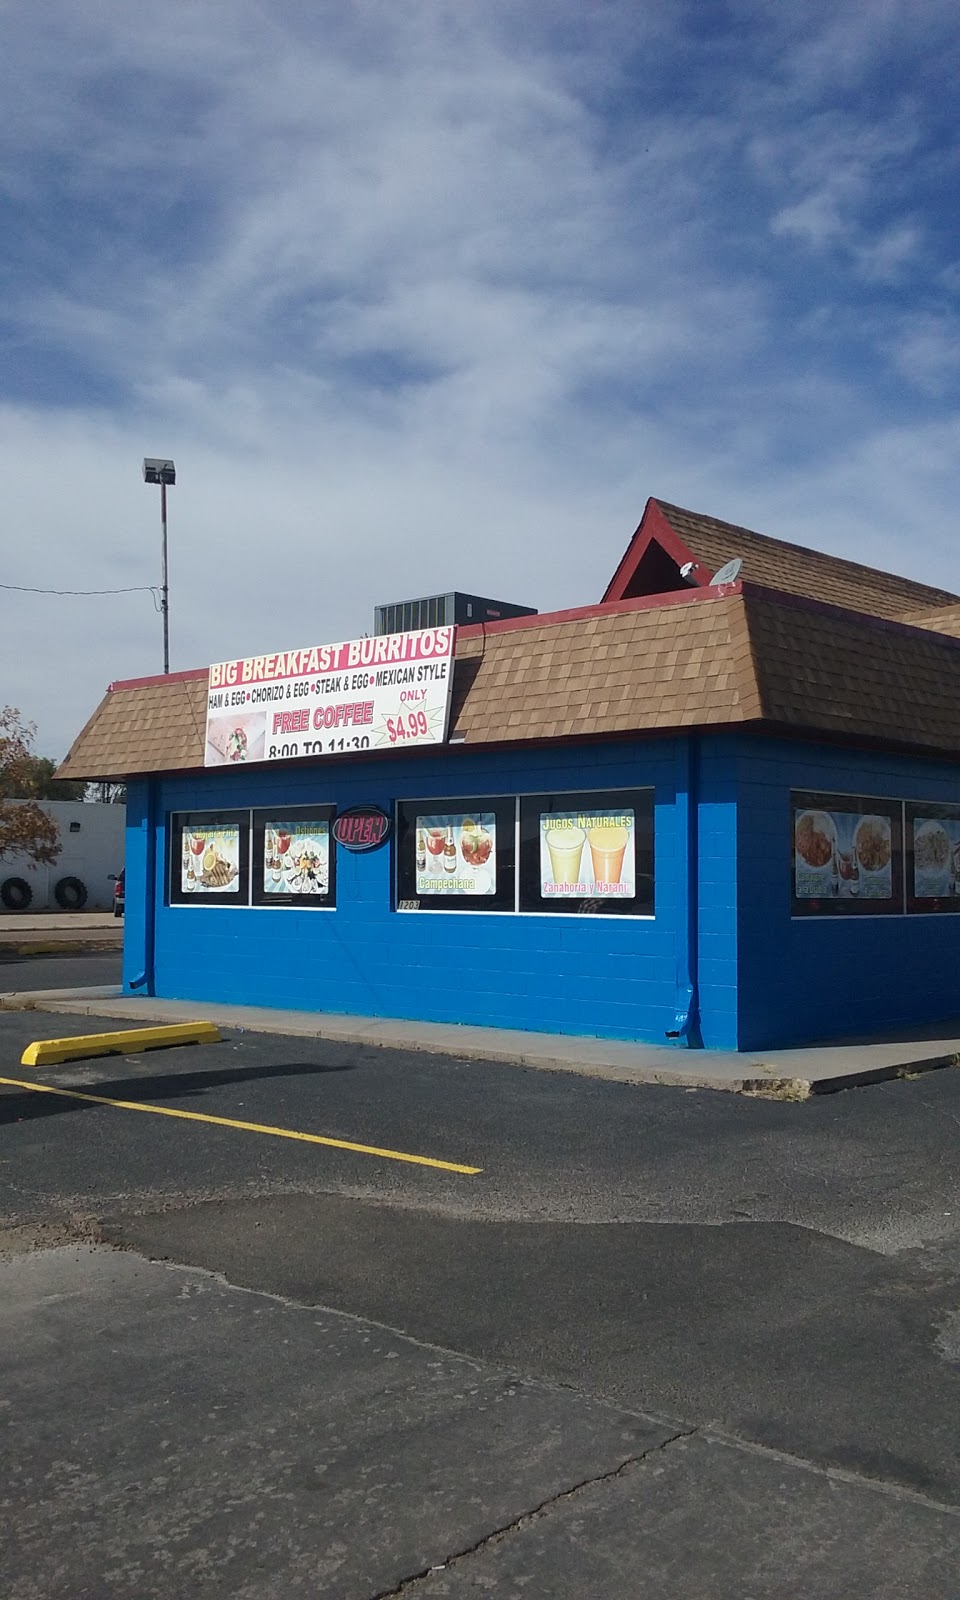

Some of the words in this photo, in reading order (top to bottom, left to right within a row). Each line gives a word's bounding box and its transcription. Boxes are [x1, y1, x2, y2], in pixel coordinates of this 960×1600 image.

[211, 661, 238, 687] BIG
[241, 645, 344, 683] BREAKFAST
[346, 628, 449, 667] BURRITOS
[208, 695, 223, 710] HAM
[224, 693, 230, 707] &
[231, 690, 246, 706] EGG
[251, 684, 284, 704] CHORIZO
[286, 684, 291, 699] &
[293, 681, 309, 698] EGG
[315, 676, 341, 695] STEAK
[343, 676, 349, 691] &
[351, 673, 369, 690] EGG
[375, 665, 415, 687] MEXICAN
[417, 662, 447, 682] STYLE
[400, 688, 427, 702] ONLY
[272, 708, 311, 735] FREE
[313, 700, 375, 731] COFFEE
[386, 711, 428, 743] $4.99
[303, 740, 323, 755] TO
[337, 816, 384, 844] OPEN
[543, 816, 573, 830] JUGOS
[577, 814, 632, 829] NATURALES
[420, 876, 475, 891] Campechana
[544, 881, 586, 894] Zanahoria
[589, 883, 594, 896] y
[400, 900, 419, 910] 1203
